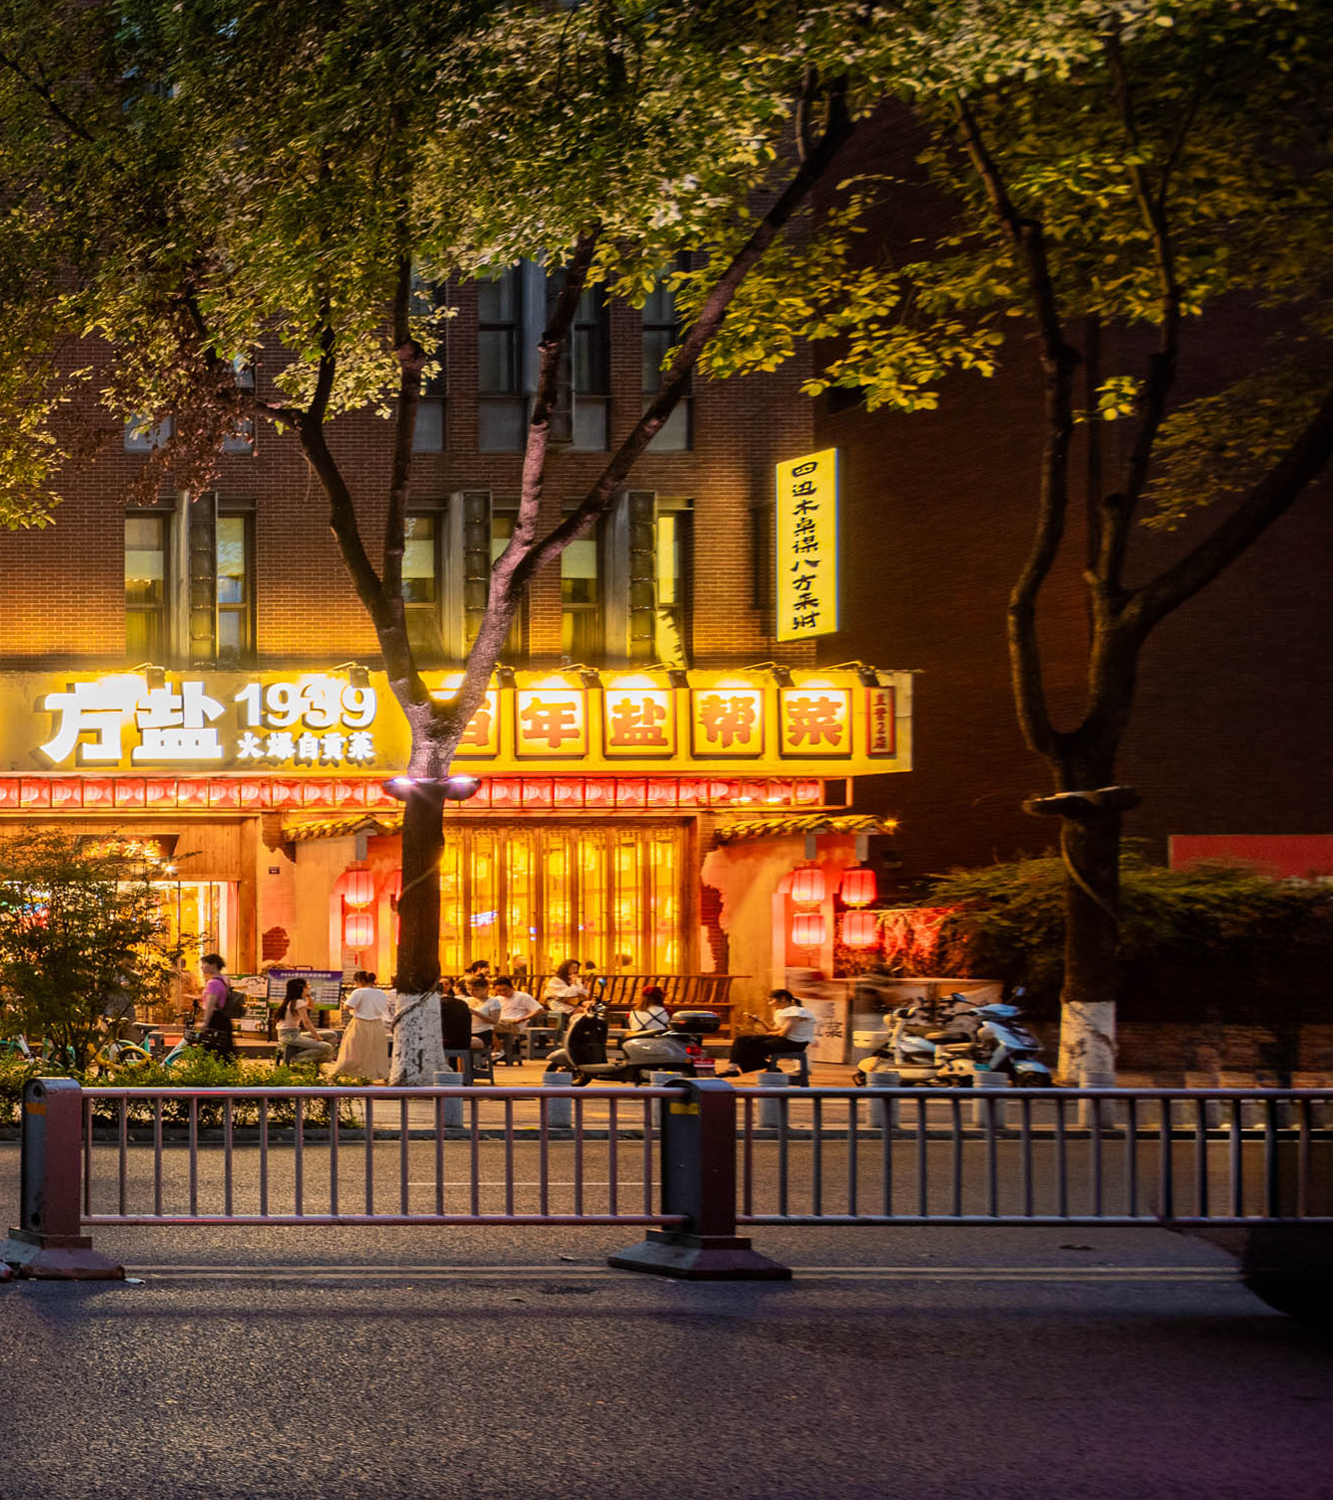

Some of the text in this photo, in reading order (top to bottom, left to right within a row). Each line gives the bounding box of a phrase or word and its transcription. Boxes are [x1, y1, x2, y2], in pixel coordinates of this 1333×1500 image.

[40, 681, 377, 764] 方盐 1939
[236, 732, 376, 761] 火爆自贡菜
